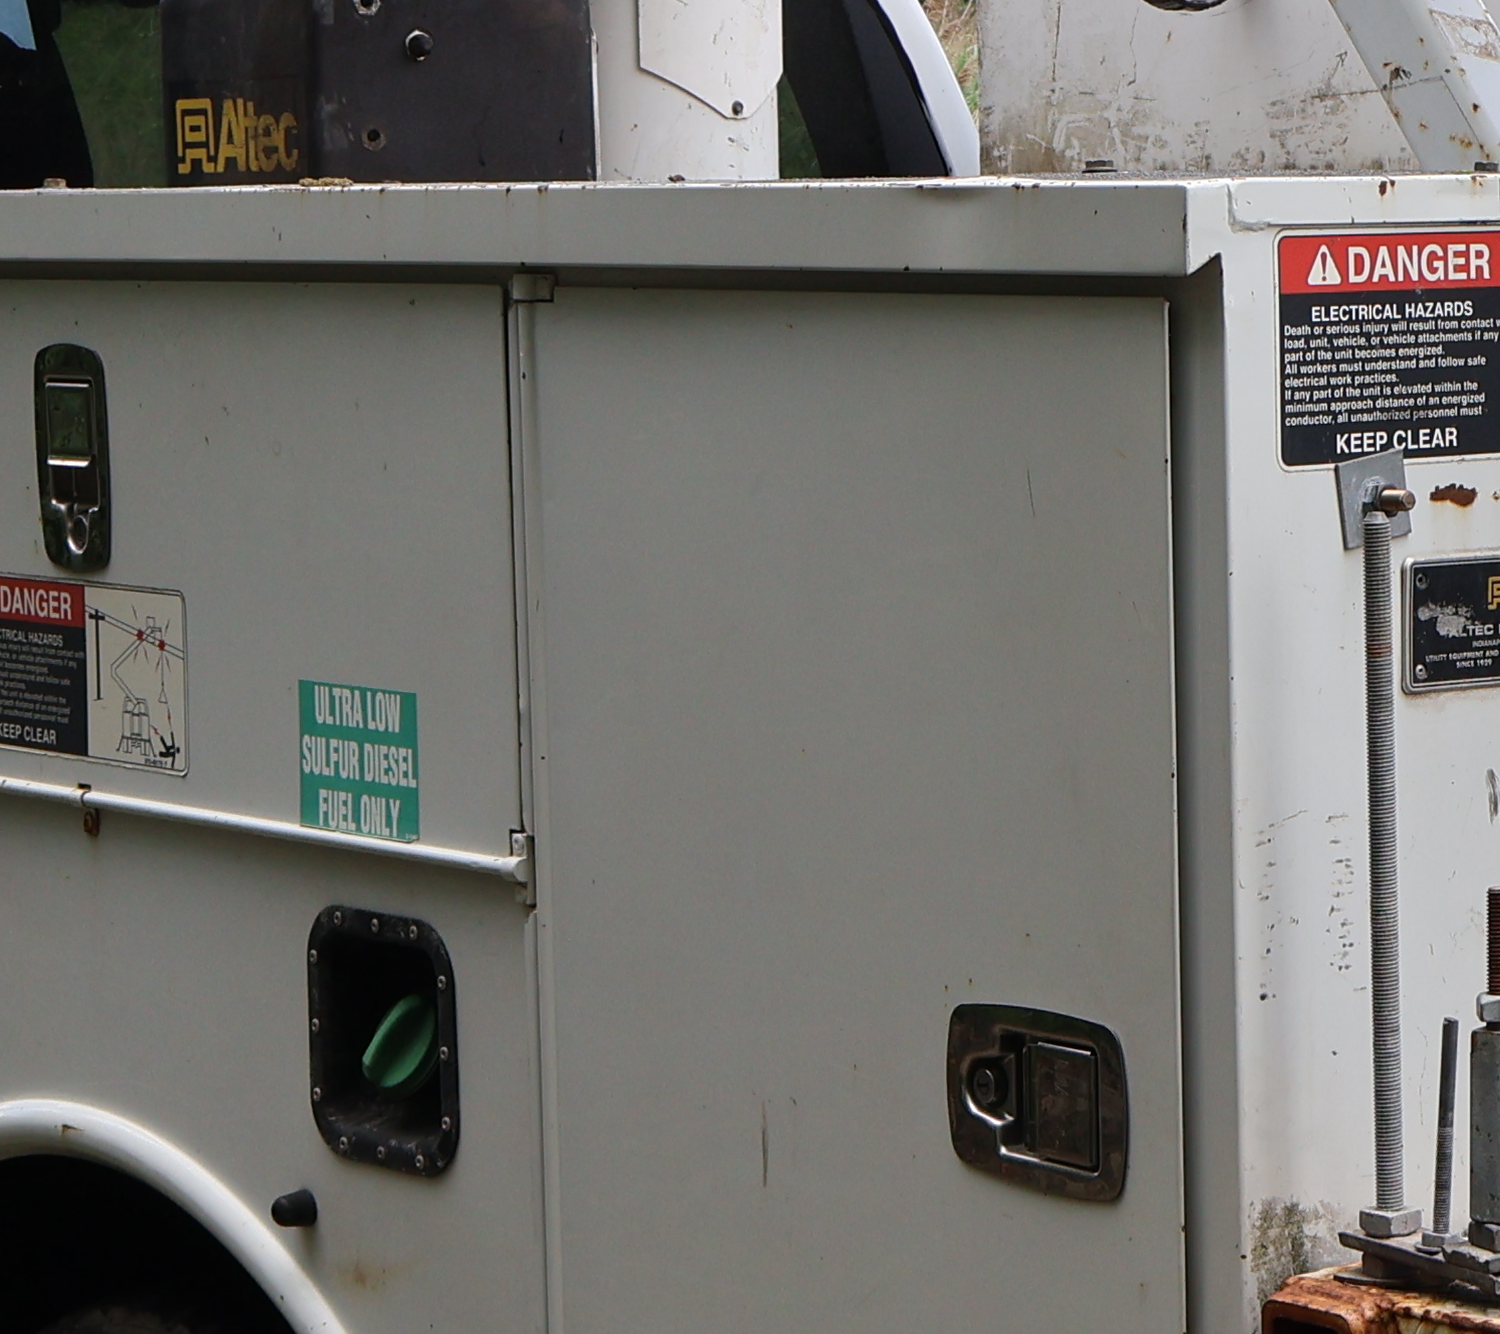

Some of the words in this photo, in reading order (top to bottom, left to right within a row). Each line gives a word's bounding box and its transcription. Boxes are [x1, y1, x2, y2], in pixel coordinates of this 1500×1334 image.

[215, 98, 298, 172] Altec
[1348, 243, 1491, 284] DANGER
[1311, 303, 1402, 322] ELECTRICAL
[1405, 300, 1474, 318] HAZARDS
[1284, 324, 1311, 336] Death
[1313, 326, 1323, 335] or
[1326, 322, 1360, 334] serious
[1362, 321, 1389, 335] injury
[1391, 320, 1407, 331] will
[1409, 319, 1435, 331] result
[1437, 318, 1458, 332] from
[1460, 318, 1493, 331] contact
[1284, 337, 1307, 349] load,
[1310, 336, 1330, 348] unit,
[1332, 334, 1368, 348] vehicle,
[1370, 333, 1380, 347] or
[1382, 332, 1415, 345] vehicle
[1417, 330, 1472, 345] attachments
[1474, 330, 1480, 340] if
[1483, 331, 1499, 342] any
[1284, 351, 1303, 363] part
[1305, 349, 1315, 361] of
[1317, 349, 1332, 360] the
[1334, 348, 1352, 359] unit
[1354, 346, 1396, 358] becomes
[1398, 344, 1445, 359] energized.
[1284, 362, 1297, 374] All
[1300, 362, 1337, 374] workers
[1339, 361, 1362, 372] must
[1364, 358, 1416, 371] understand
[1418, 357, 1435, 368] and
[1438, 356, 1465, 367] follow
[1467, 355, 1486, 366] safe
[1284, 375, 1327, 388] electrical
[1329, 373, 1352, 385] work
[1354, 372, 1399, 385] practices.
[1285, 389, 1291, 400] If
[1294, 391, 1310, 401] any
[1313, 388, 1331, 400] part
[1334, 386, 1343, 398] of
[1346, 384, 1360, 397] the
[1362, 385, 1380, 396] unit
[1383, 384, 1391, 395] is
[1434, 381, 1461, 392] within
[1463, 380, 1478, 394] the
[1285, 398, 1327, 413] minimum
[1330, 398, 1373, 412] approach
[1375, 396, 1414, 408] distance
[1416, 395, 1426, 406] of
[1428, 396, 1439, 405] an
[1441, 392, 1485, 408] energized
[1285, 413, 1334, 426] conductor,
[1336, 411, 1348, 423] all
[1350, 409, 1410, 422] unauthorized
[1413, 406, 1457, 421] personnel
[1460, 406, 1482, 416] must
[1336, 432, 1388, 454] KEEP
[1393, 427, 1458, 450] CLEAR
[0, 585, 72, 620] DANGER
[28, 632, 63, 647] HAZARDS
[314, 685, 363, 728] ULTRA
[367, 691, 400, 733] LOW
[23, 726, 57, 745] CLEAR
[302, 734, 359, 780] SULFUR
[364, 742, 417, 788] DIESEL
[318, 788, 357, 831] FUEL
[360, 794, 401, 837] ONLY
